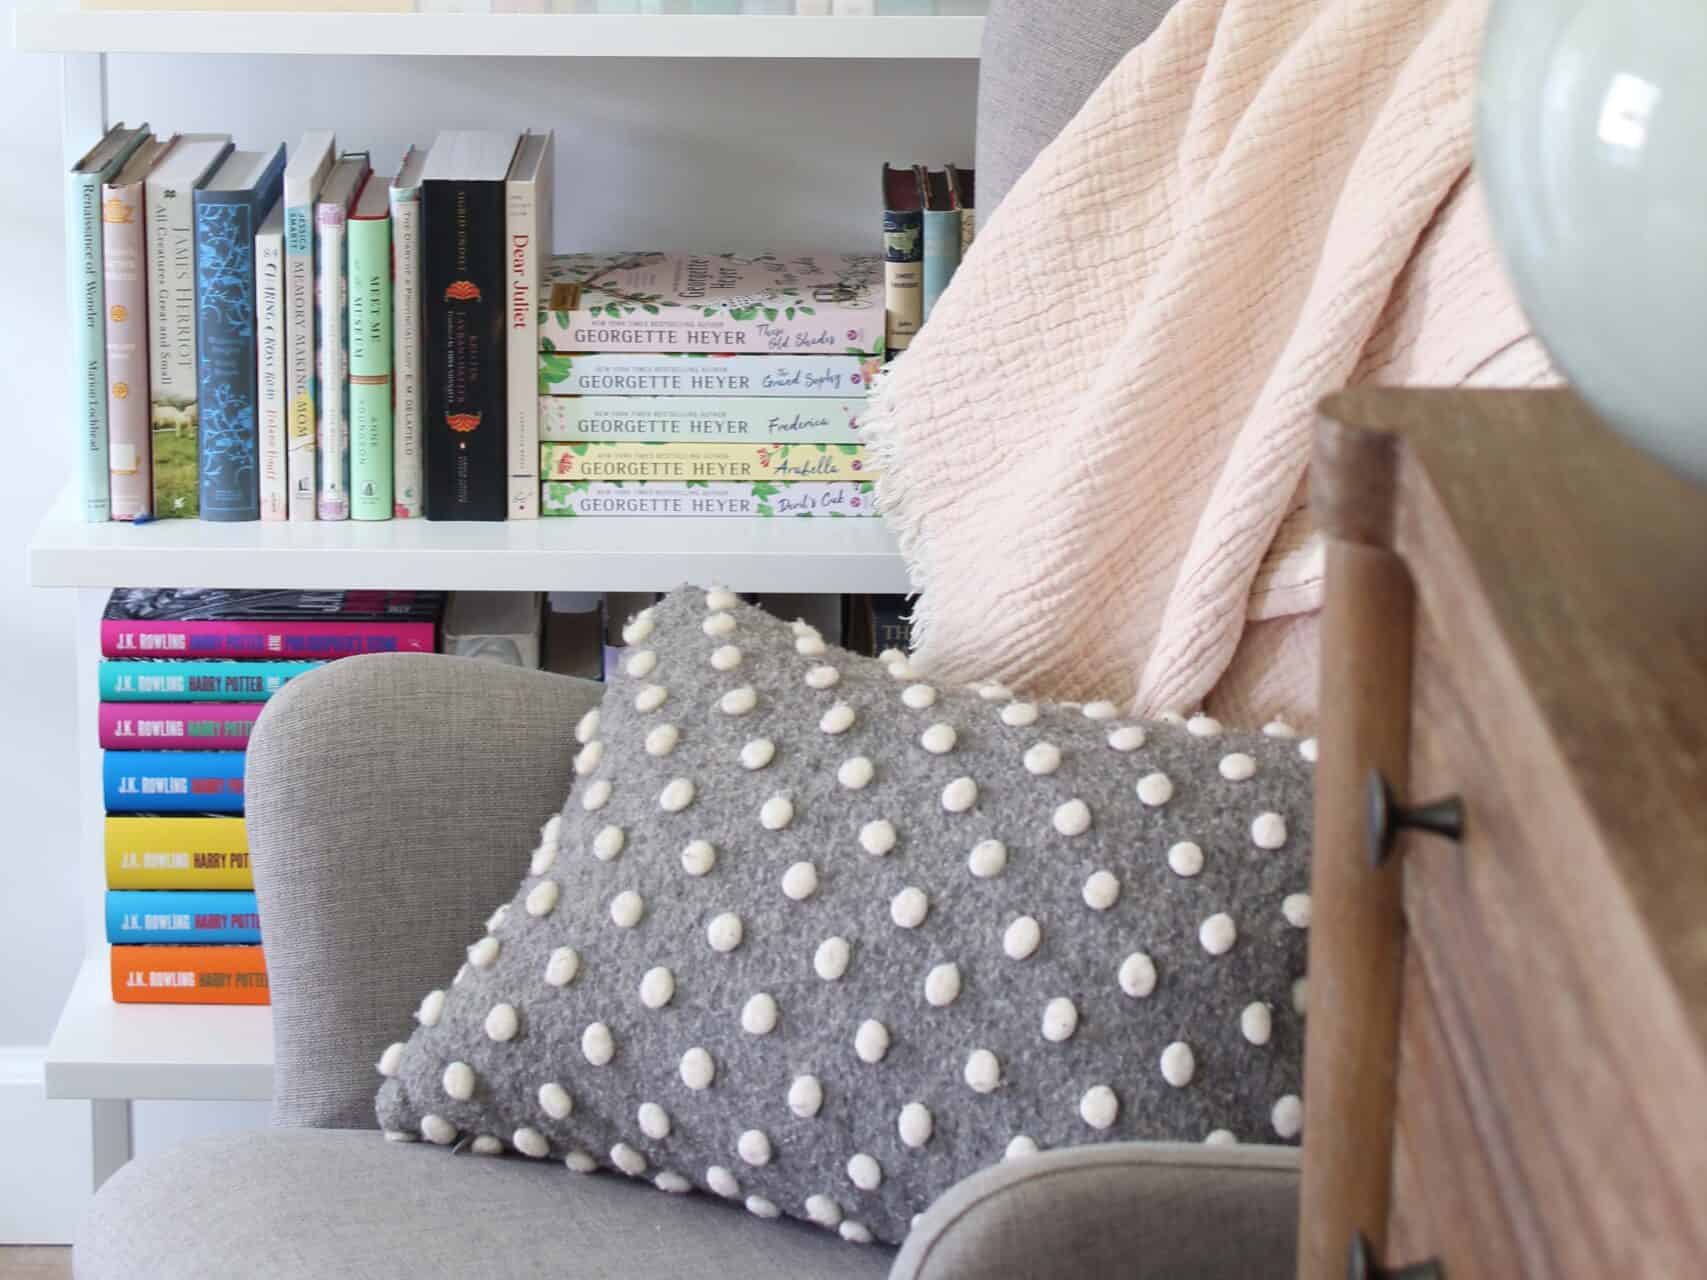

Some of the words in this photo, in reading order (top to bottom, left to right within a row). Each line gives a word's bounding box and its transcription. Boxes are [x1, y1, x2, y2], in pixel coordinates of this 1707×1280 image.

[156, 206, 168, 222] All
[82, 184, 96, 262] Renaissance
[156, 226, 169, 285] Creatures
[174, 224, 192, 280] JAMES
[512, 234, 530, 277] Dear
[84, 264, 97, 275] of
[85, 280, 98, 329] Wonder
[158, 289, 170, 321] Great
[512, 281, 530, 329] Juliet
[159, 324, 170, 348] and
[175, 288, 194, 368] HERRIOT
[574, 329, 676, 344] GEORGETTE
[687, 330, 746, 345] HEYER
[160, 352, 172, 385] Small
[87, 360, 98, 398] Marion
[578, 376, 681, 390] GEORGETTE
[691, 376, 749, 390] HEYER
[88, 400, 100, 452] Lochhead
[578, 420, 681, 434] GEORGETTE
[690, 420, 748, 434] HEYER
[580, 462, 682, 476] GEORGETTE
[693, 462, 751, 477] HEYER
[580, 498, 682, 512] GEORGETTE
[692, 498, 750, 512] HEYER
[116, 633, 137, 650] J.K.
[138, 634, 186, 650] ROWLING
[114, 675, 136, 692] J.K.
[138, 675, 184, 692] ROWLING
[189, 676, 222, 691] HARRY
[224, 676, 263, 691] POTTER
[114, 720, 136, 736] J.K.
[137, 720, 184, 736] ROWLING
[118, 776, 138, 794] J.K.
[142, 777, 188, 794] ROWLING
[120, 852, 141, 868] J.K.
[143, 853, 190, 868] ROWLING
[194, 853, 226, 868] HARRY
[121, 914, 142, 930] J.K.
[144, 914, 190, 930] ROWLING
[126, 972, 148, 988] J.K.
[149, 972, 196, 988] ROWLING
